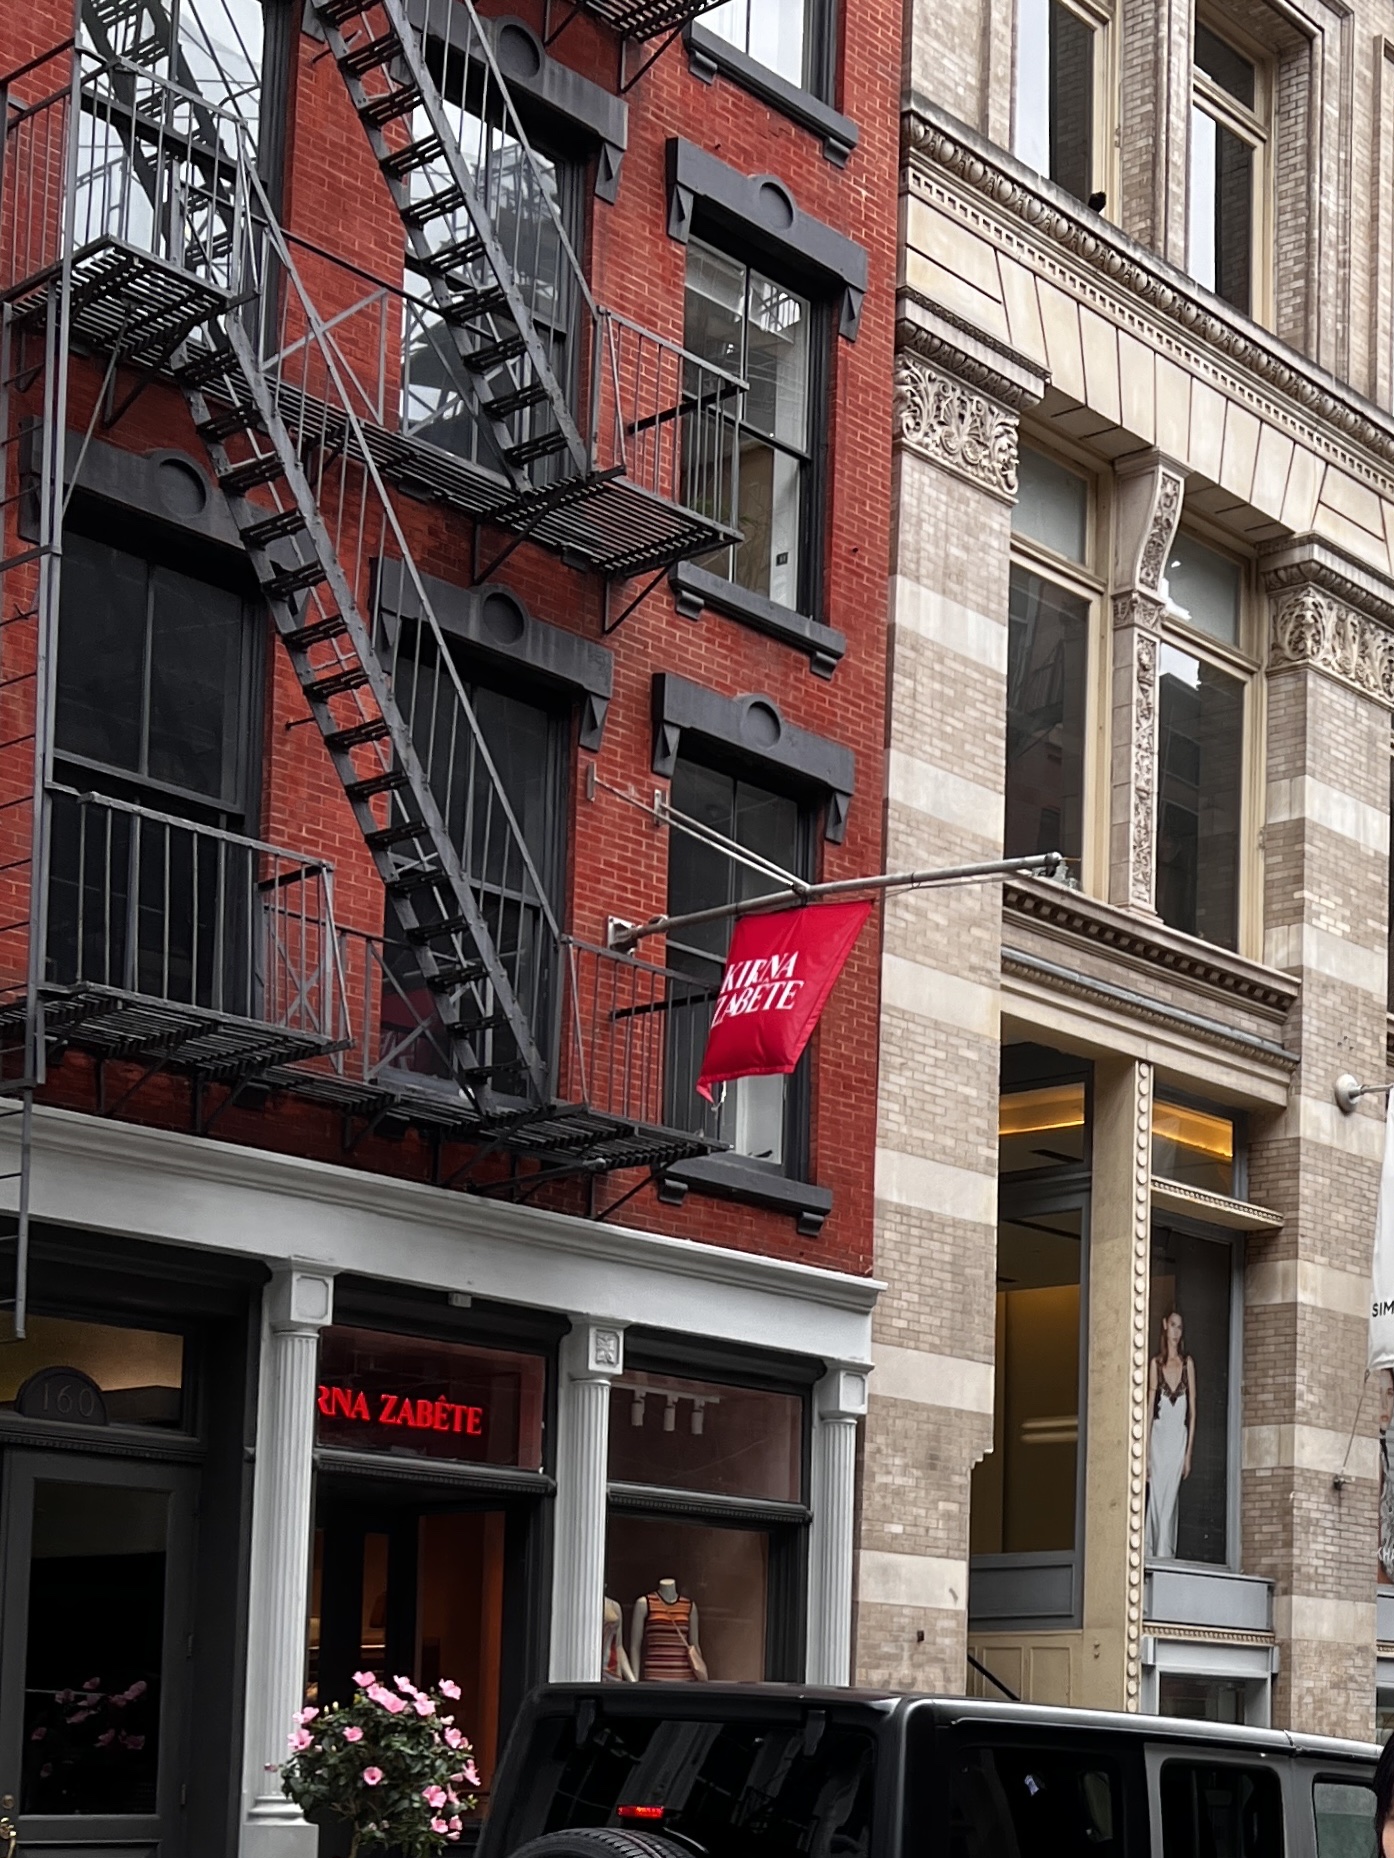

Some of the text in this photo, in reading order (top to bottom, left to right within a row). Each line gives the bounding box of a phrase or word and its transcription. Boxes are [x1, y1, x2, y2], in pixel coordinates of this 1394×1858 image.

[720, 951, 799, 994] KIRNA
[43, 1383, 94, 1418] 160
[379, 1393, 483, 1435] ZABÊTE
